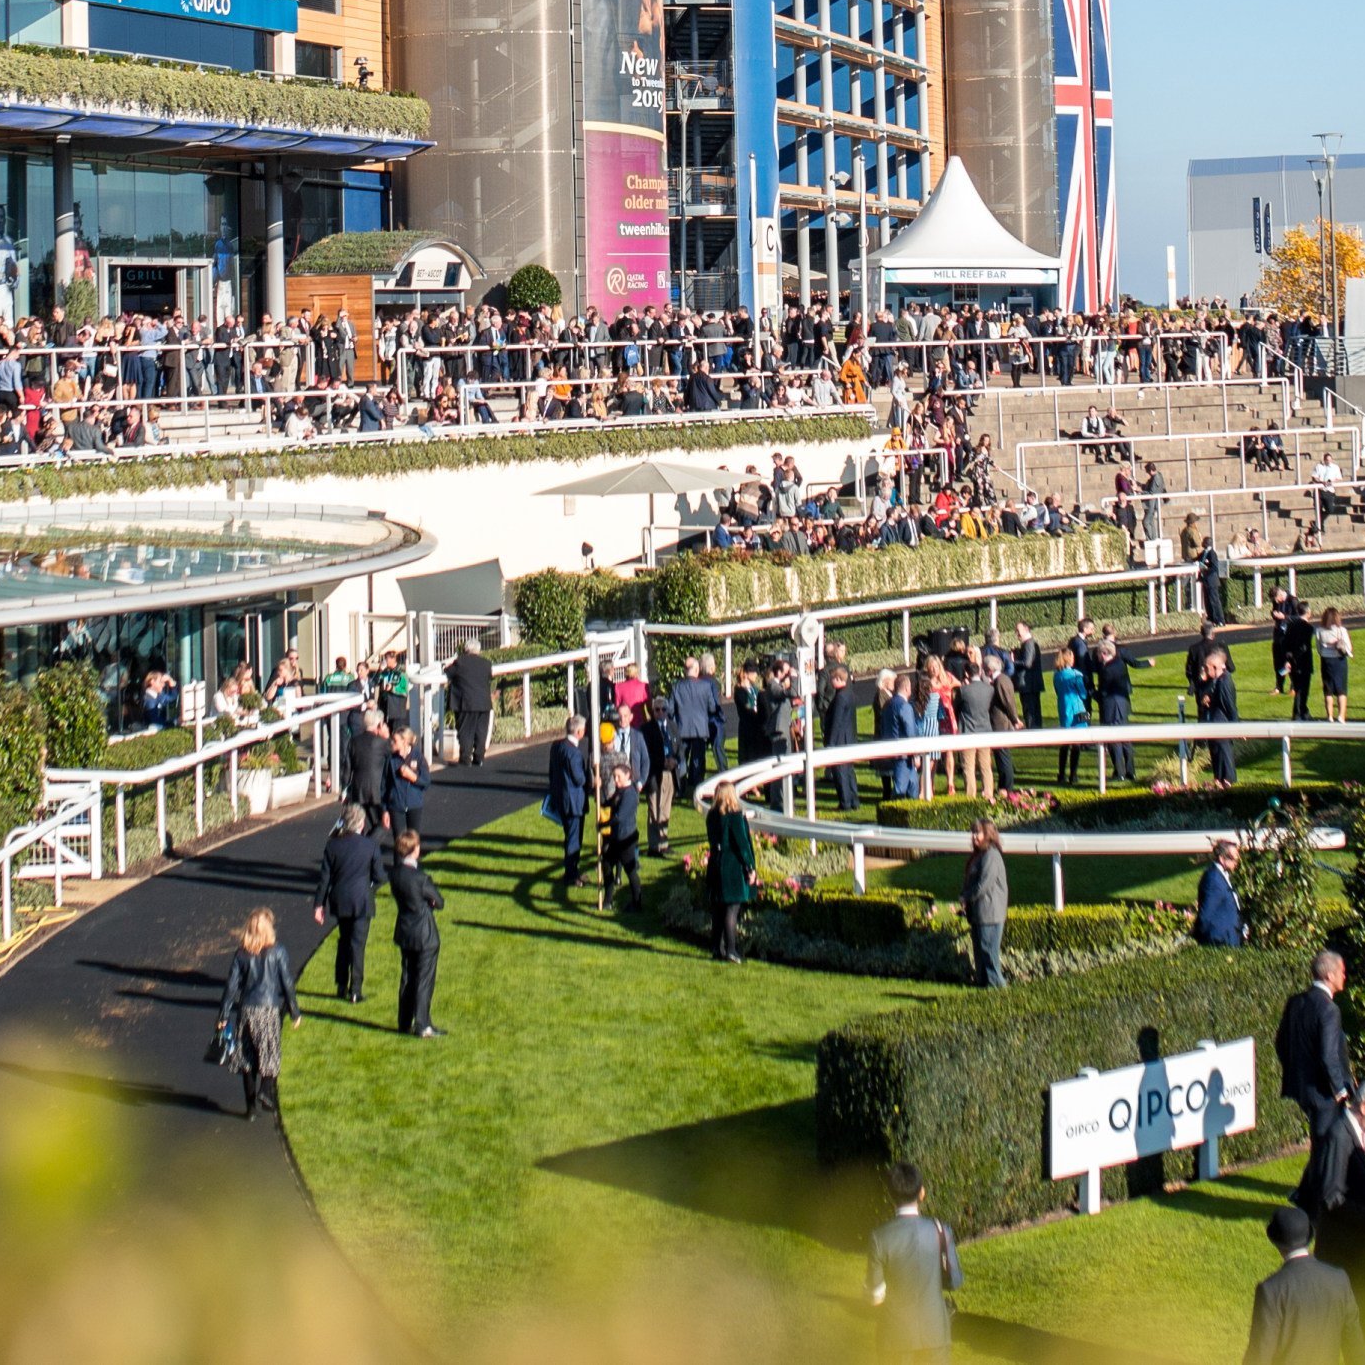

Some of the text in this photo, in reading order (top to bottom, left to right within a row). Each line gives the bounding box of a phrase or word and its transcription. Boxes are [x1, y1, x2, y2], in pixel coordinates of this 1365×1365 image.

[619, 51, 658, 76] New
[631, 76, 640, 86] to
[624, 194, 653, 210] older
[126, 269, 164, 281] GRILL
[933, 270, 1007, 279] MILL REEF BAR
[1108, 1079, 1208, 1133] QIPCO
[1065, 1121, 1100, 1139] QIPCO
